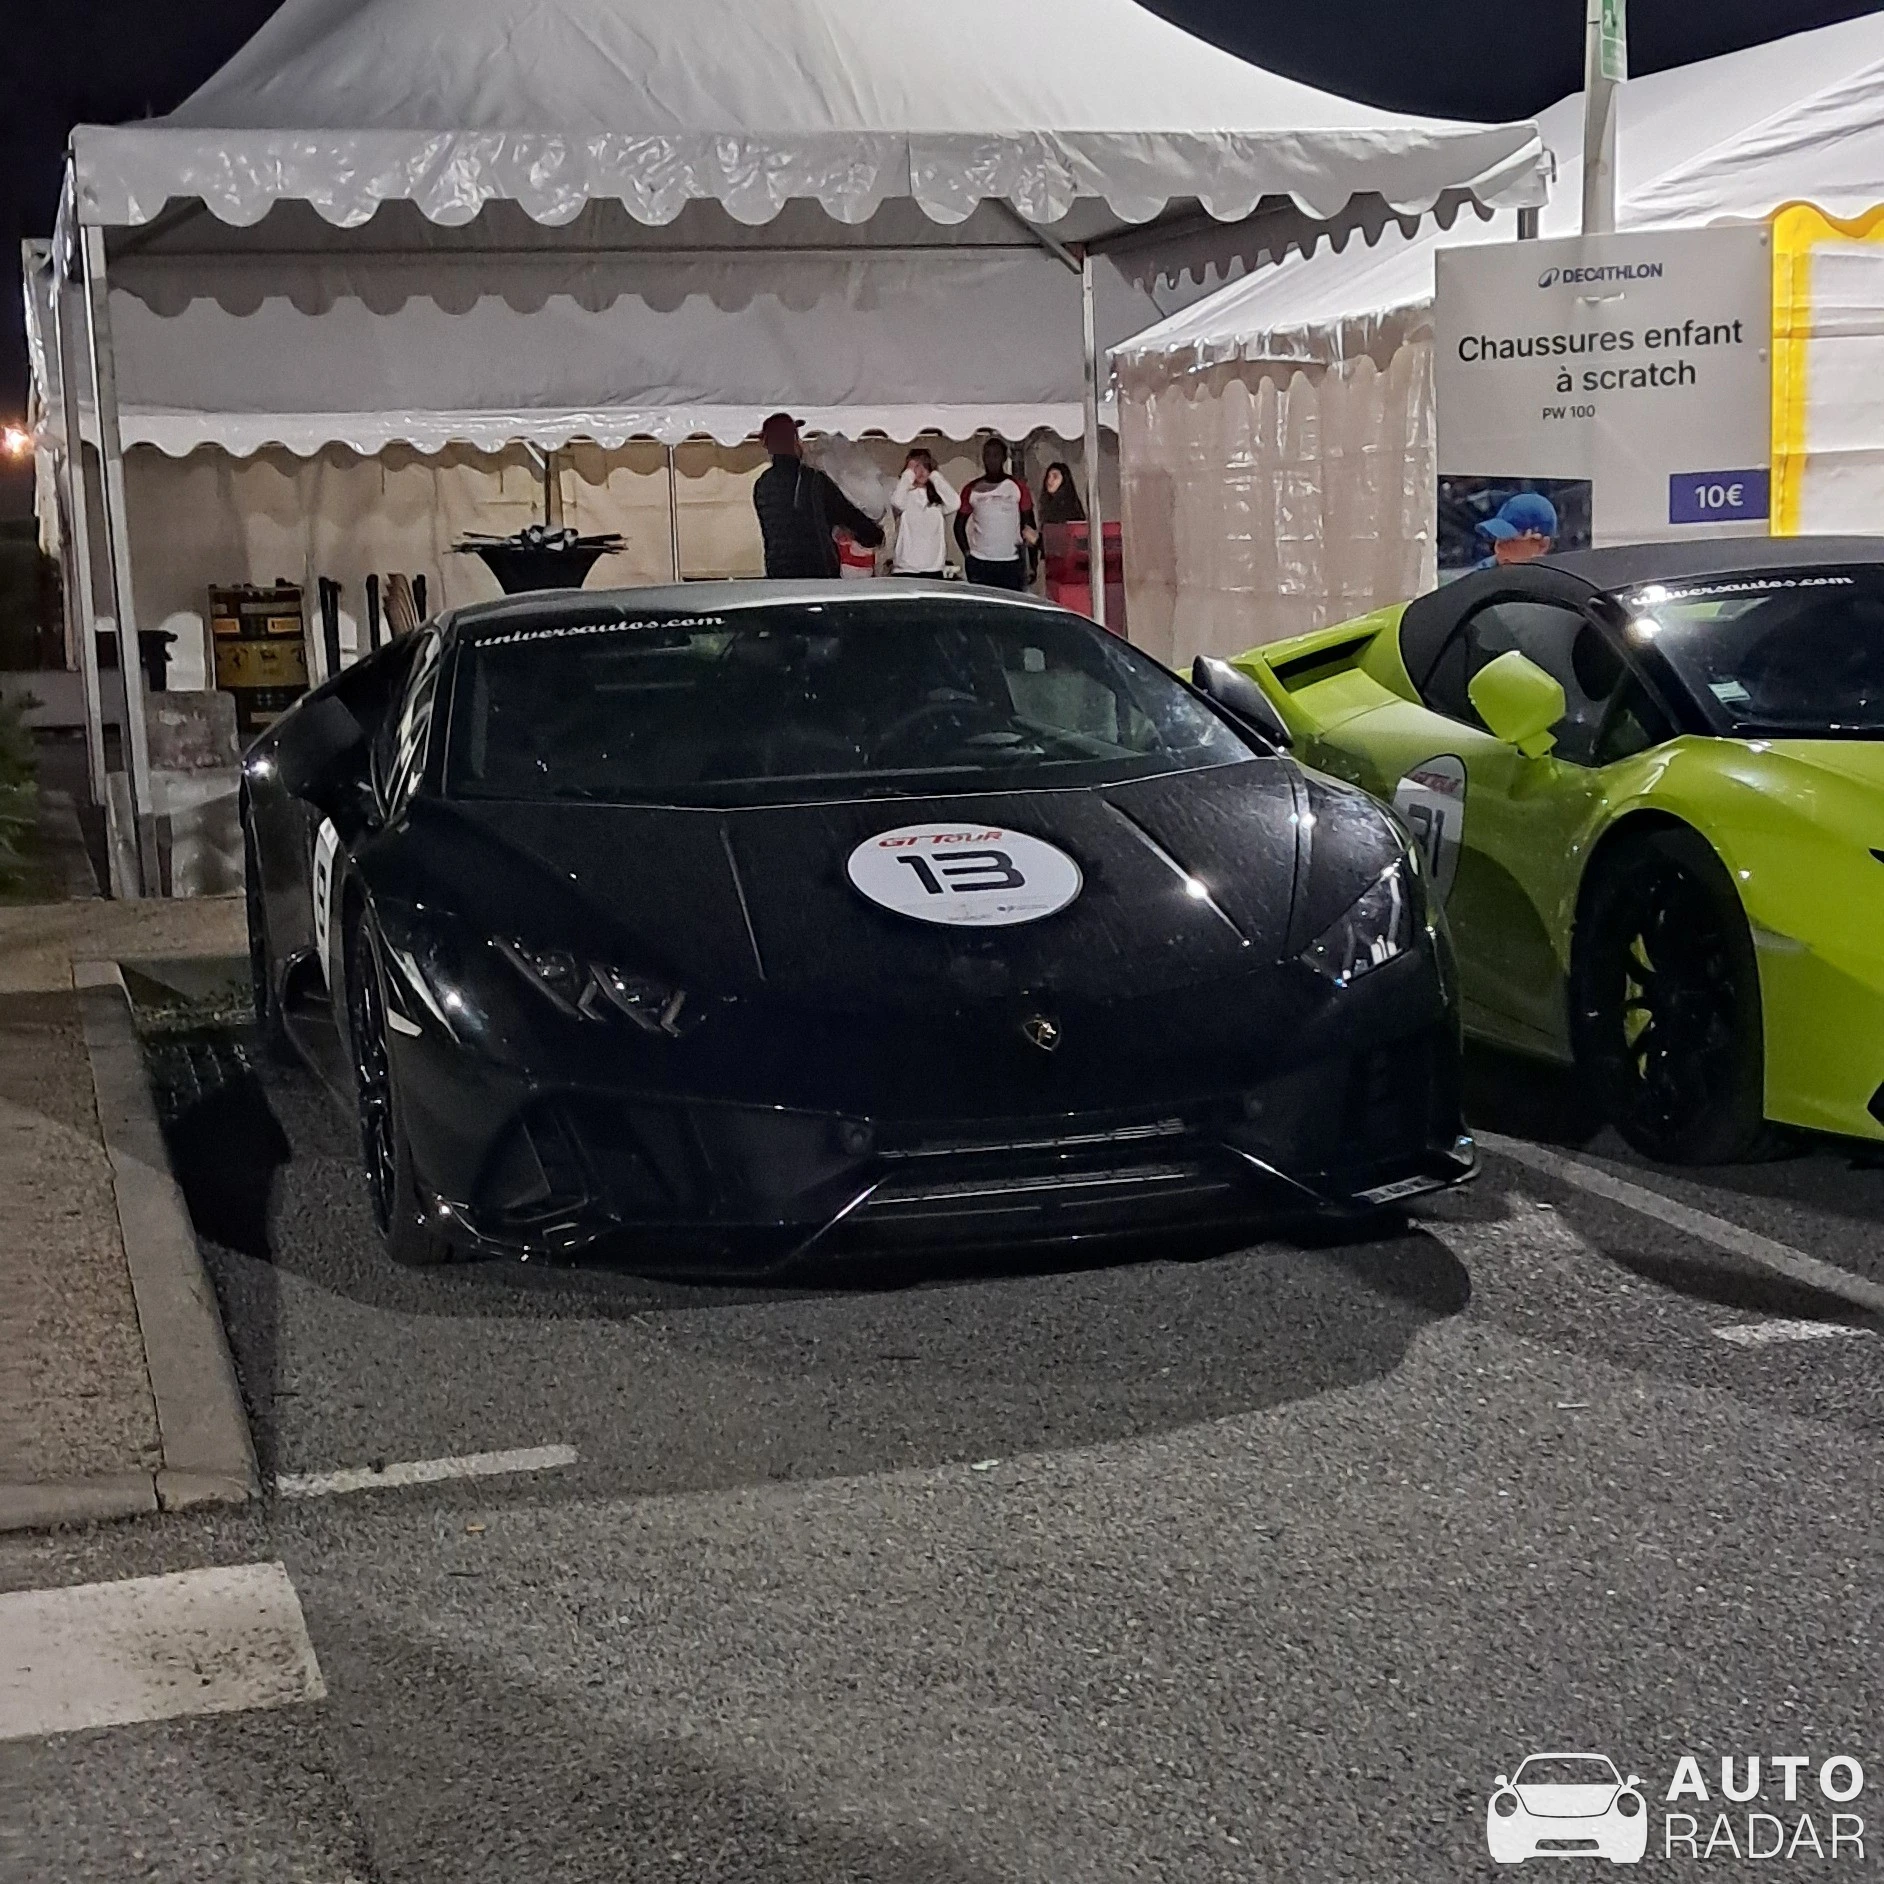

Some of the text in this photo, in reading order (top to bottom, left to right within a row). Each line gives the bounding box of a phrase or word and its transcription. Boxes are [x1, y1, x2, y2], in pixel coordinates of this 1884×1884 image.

[1563, 263, 1663, 284] DECATHLON
[1458, 319, 1744, 362] Chaussures enfant
[1556, 360, 1697, 393] à scratch
[1542, 405, 1596, 420] PW 100
[1694, 484, 1744, 509] 10€
[474, 616, 727, 648] universautos.com
[896, 849, 1026, 894] 13
